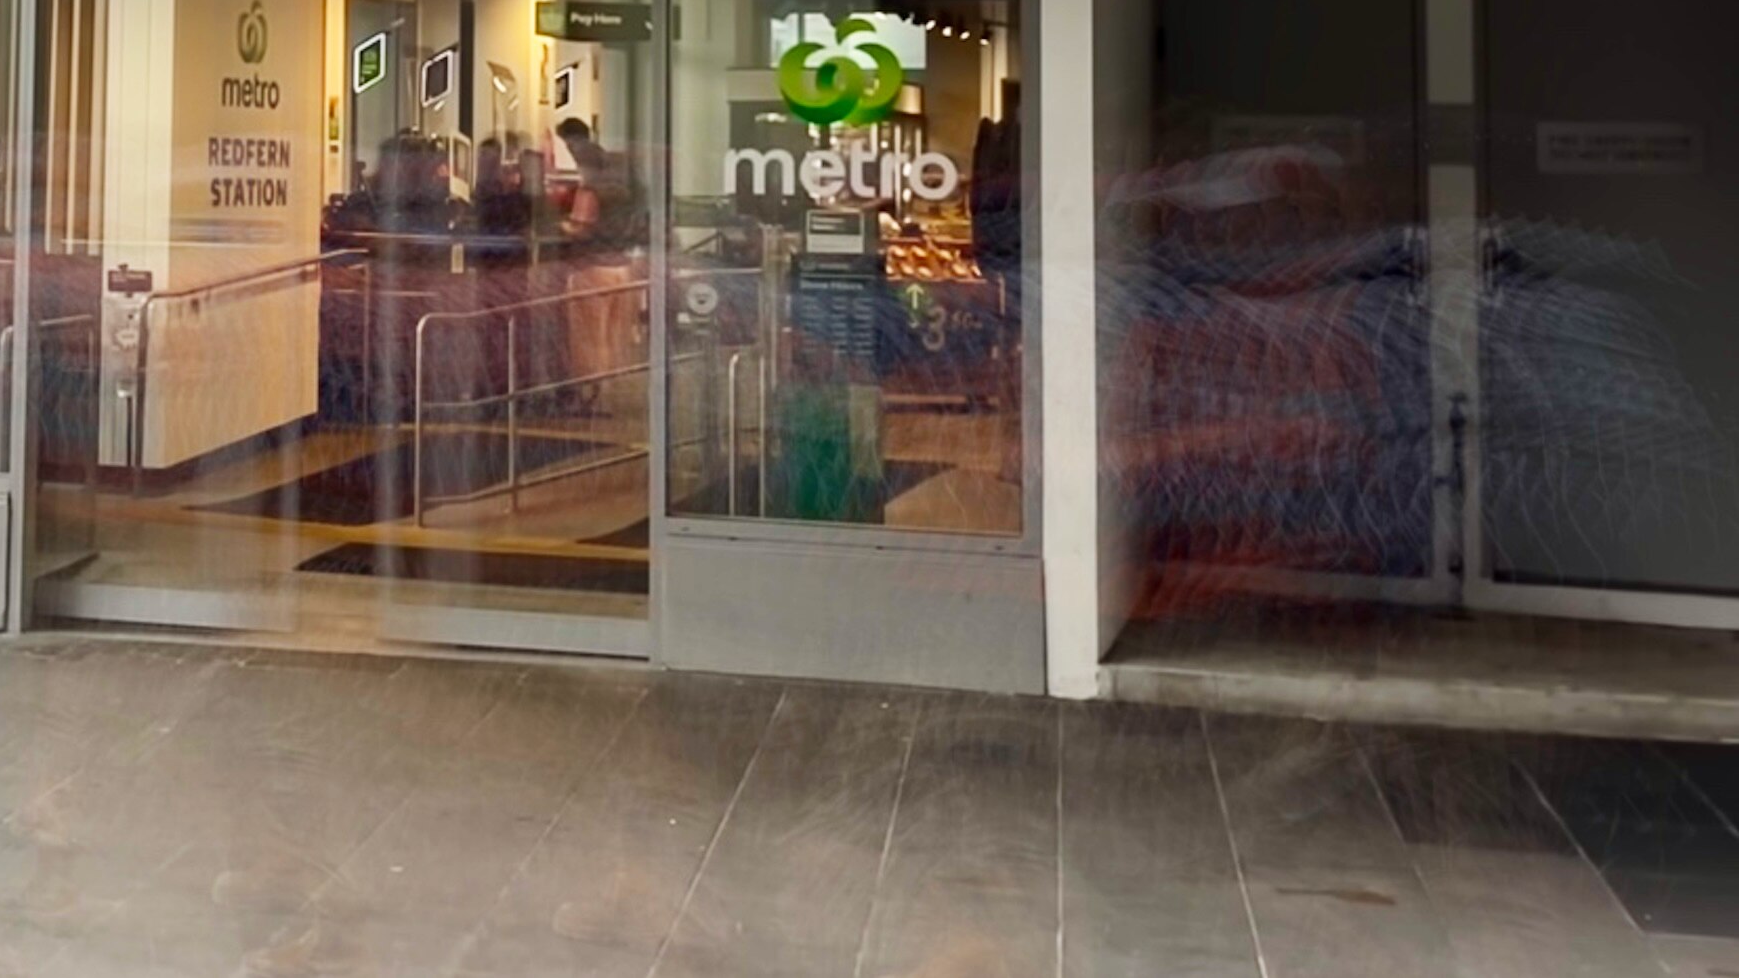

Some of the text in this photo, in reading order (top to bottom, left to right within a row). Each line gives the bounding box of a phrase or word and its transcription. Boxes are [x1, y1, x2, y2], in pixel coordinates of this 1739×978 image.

[221, 73, 280, 110] metro
[207, 136, 291, 168] REDFERN
[726, 138, 958, 201] metro
[210, 177, 288, 207] STATION
